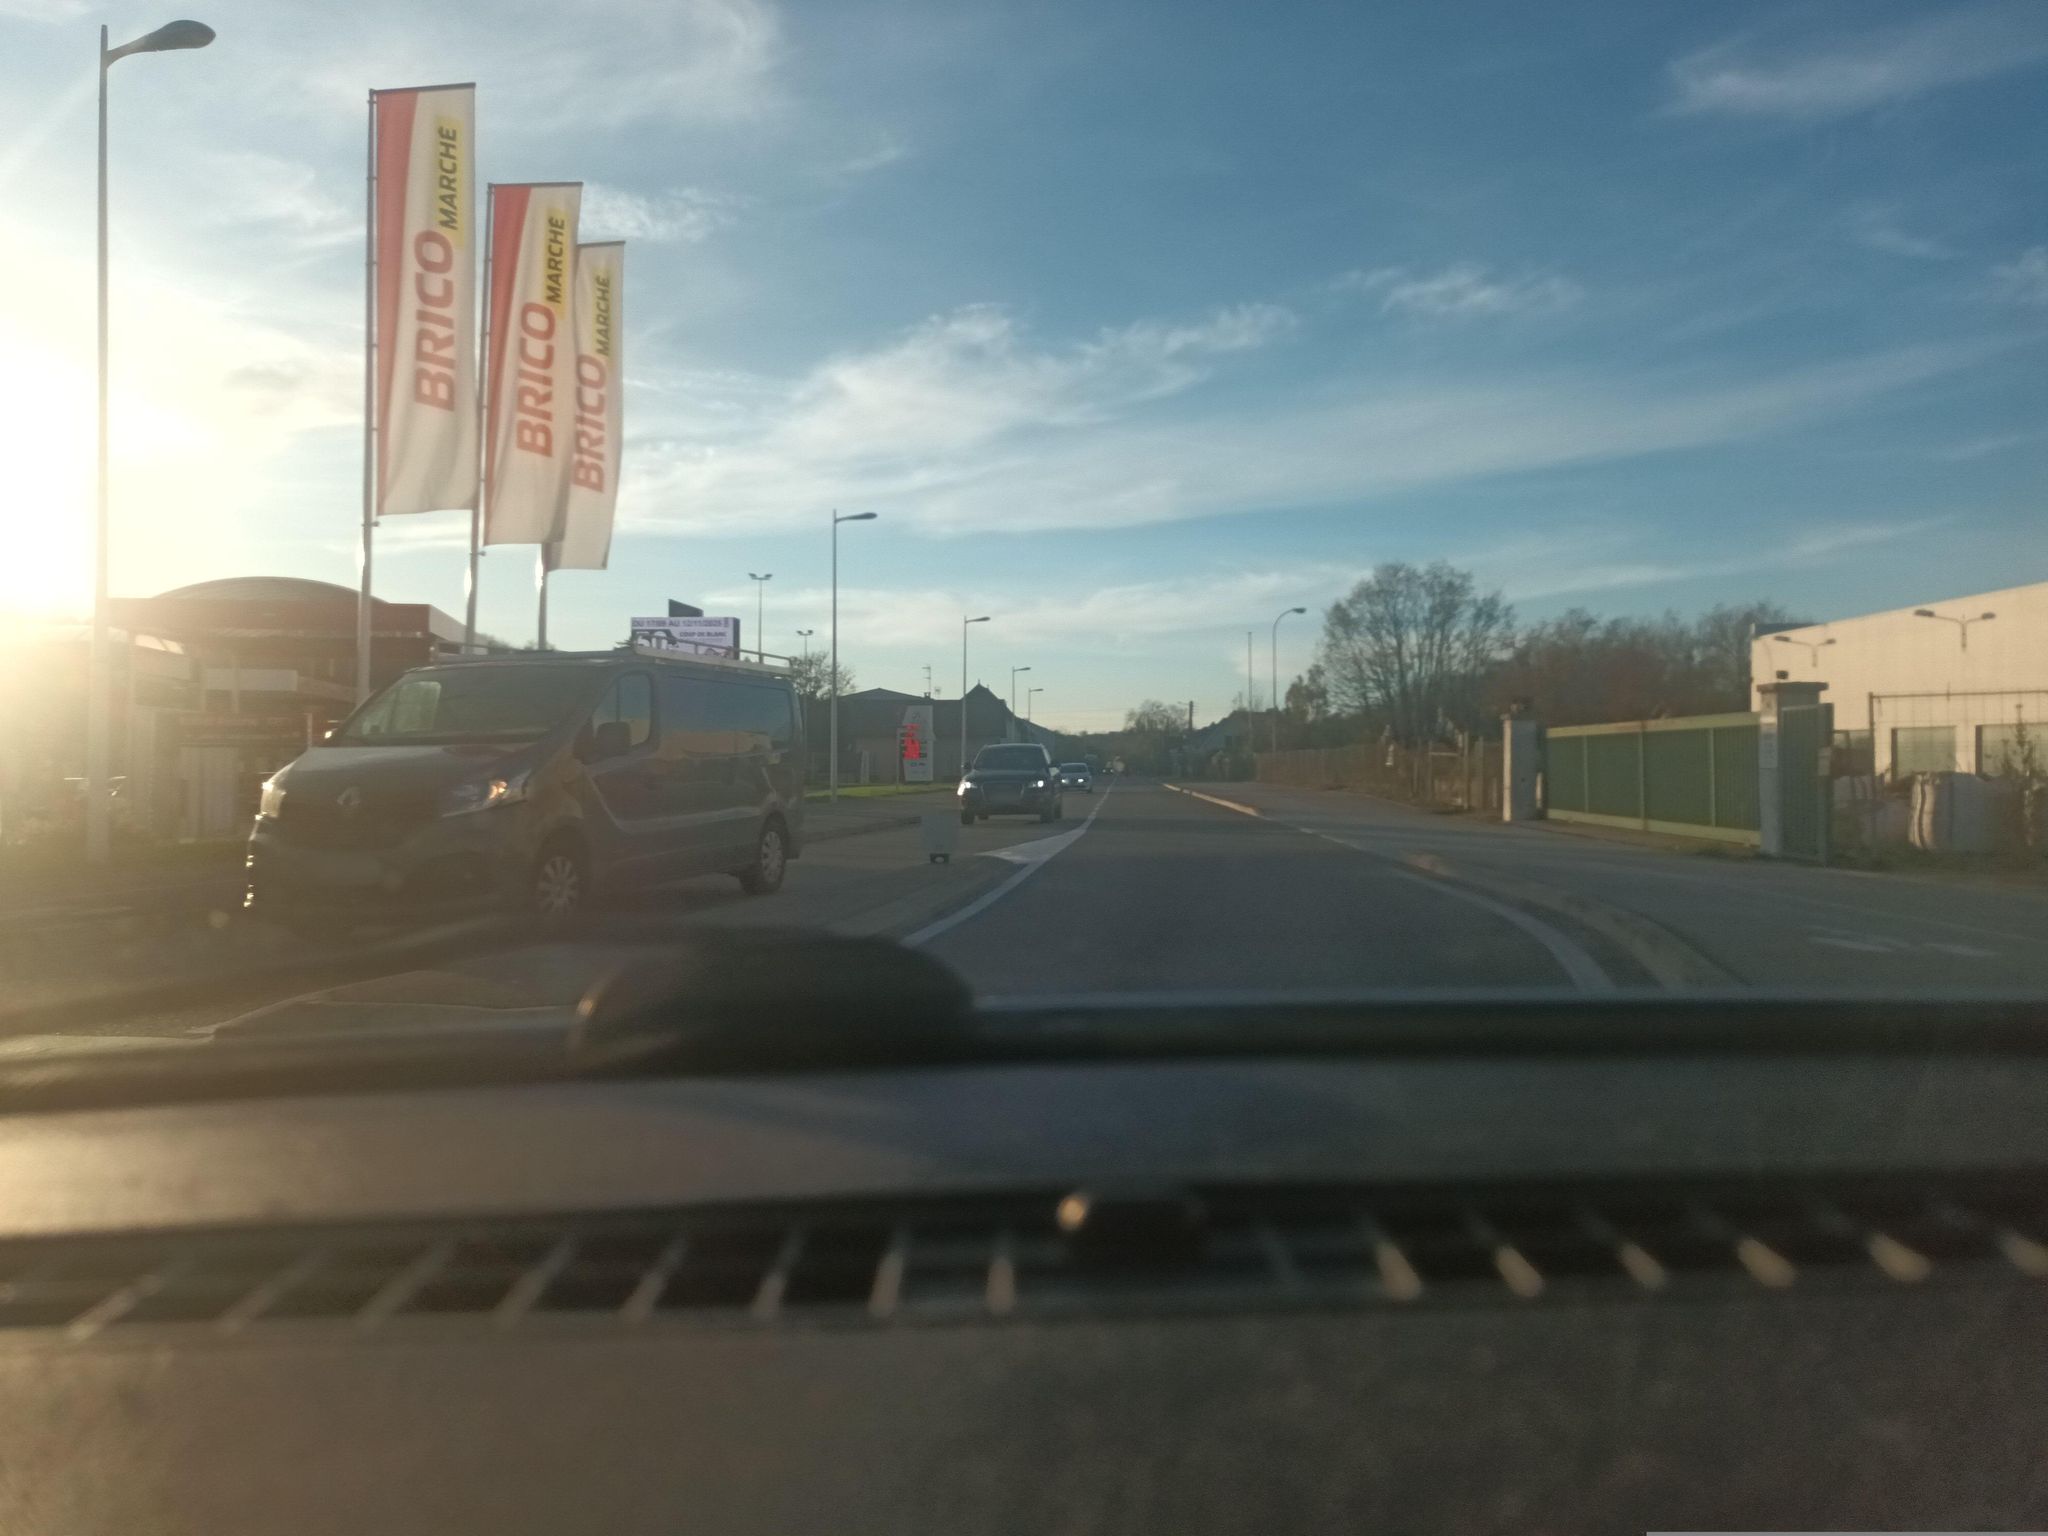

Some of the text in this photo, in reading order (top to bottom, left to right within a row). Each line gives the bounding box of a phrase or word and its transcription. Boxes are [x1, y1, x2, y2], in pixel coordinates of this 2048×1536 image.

[413, 229, 456, 412] BRICO
[516, 302, 556, 458] BRICO
[572, 353, 607, 493] BRICO
